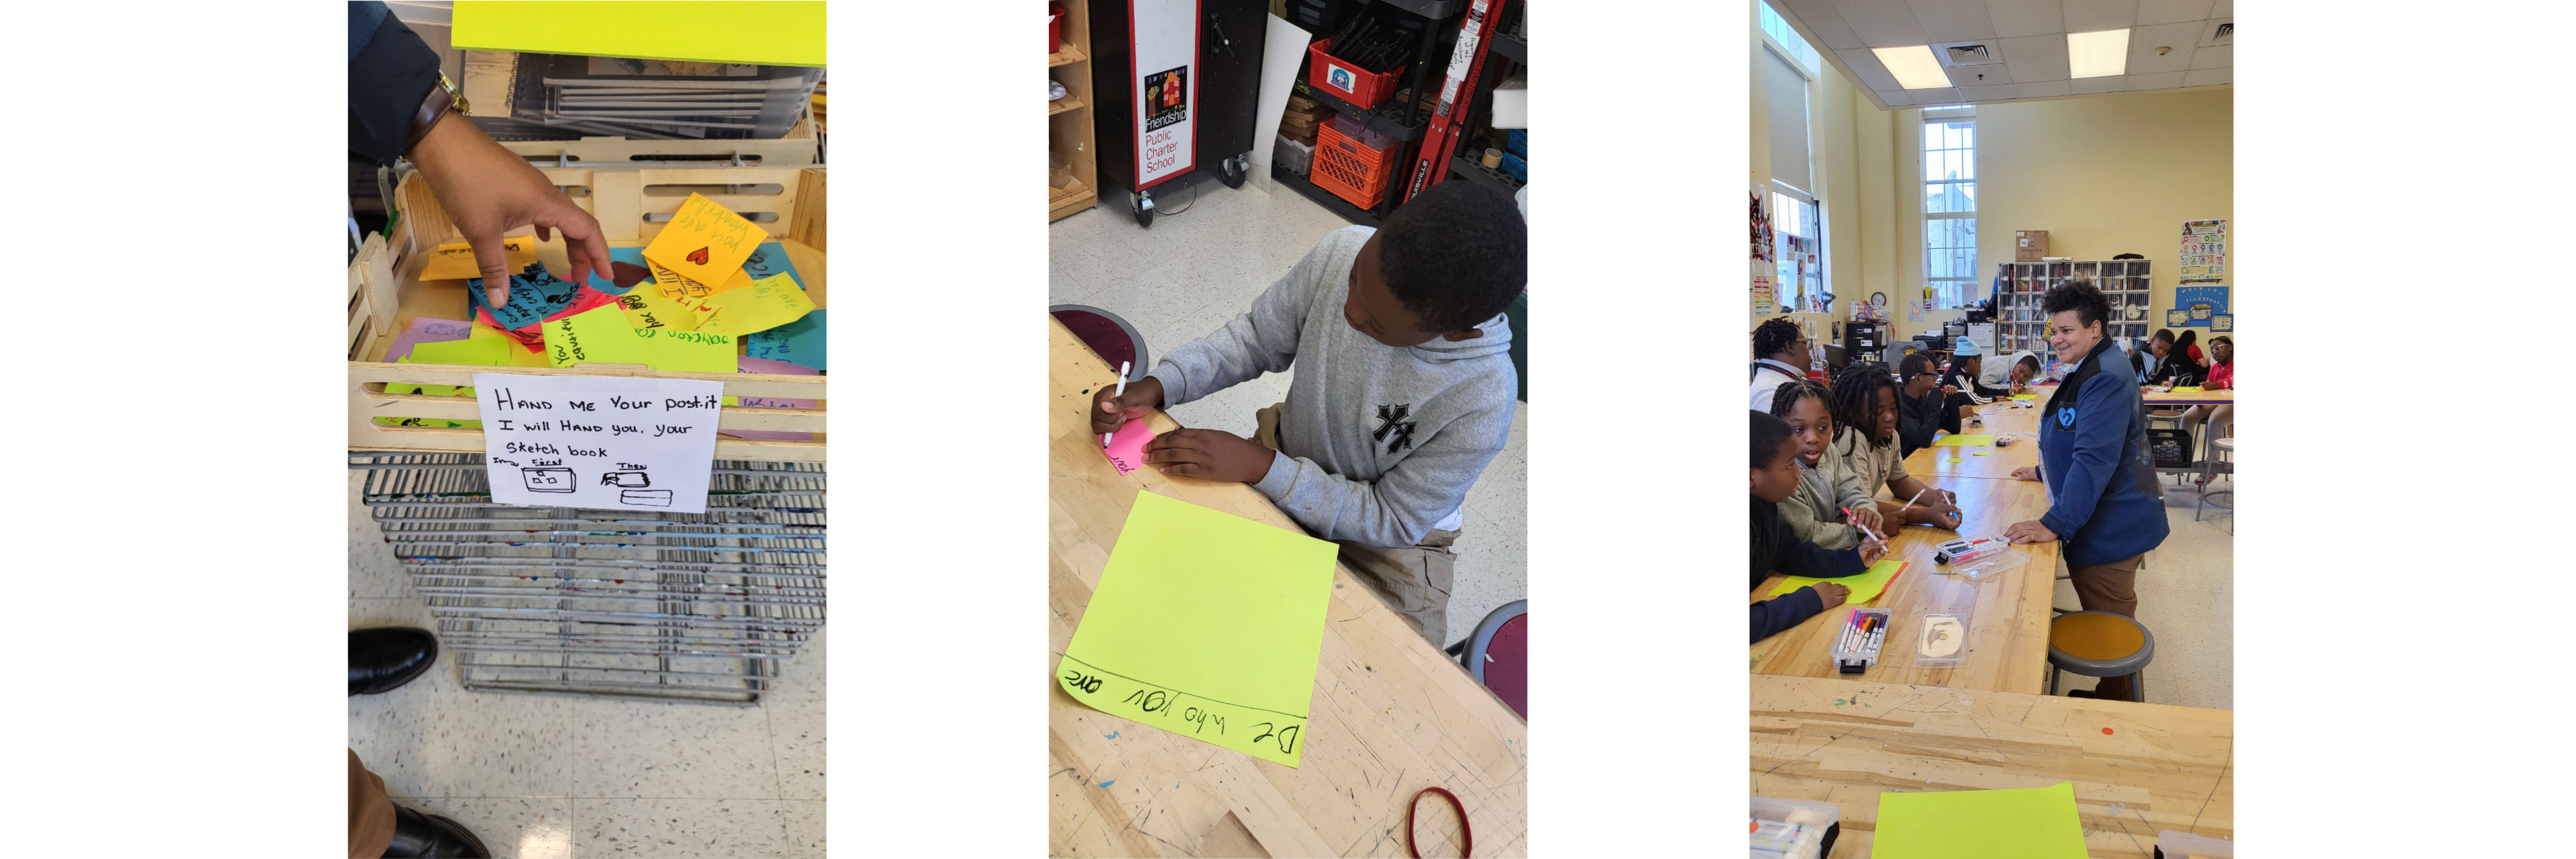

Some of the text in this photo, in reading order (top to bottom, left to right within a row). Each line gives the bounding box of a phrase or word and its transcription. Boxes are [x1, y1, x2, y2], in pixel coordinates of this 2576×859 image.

[1146, 109, 1186, 131] Friendship
[1146, 129, 1172, 147] Public
[1146, 141, 1178, 160] Charter
[1147, 153, 1175, 173] School
[570, 400, 595, 411] ME
[498, 420, 514, 431] I
[568, 445, 607, 457] book
